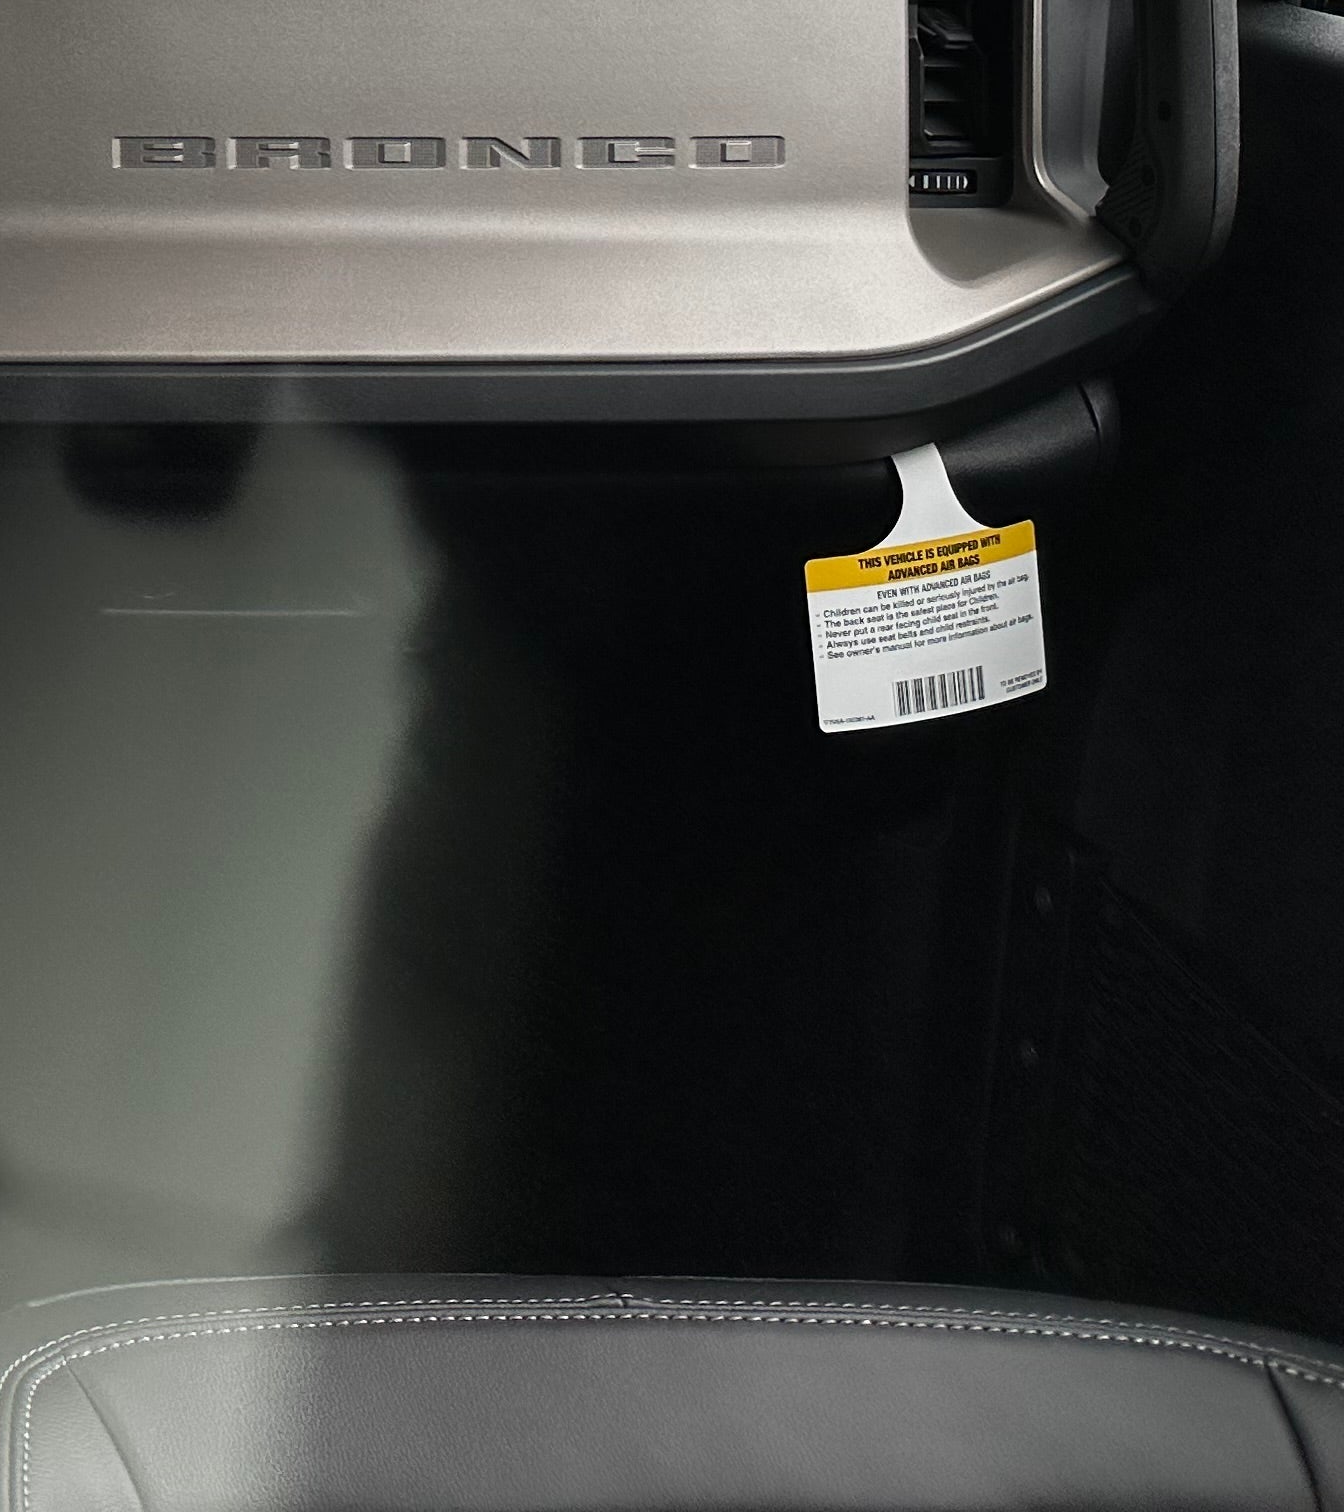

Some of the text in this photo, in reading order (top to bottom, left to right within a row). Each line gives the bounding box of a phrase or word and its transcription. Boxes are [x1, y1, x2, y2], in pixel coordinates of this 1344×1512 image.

[113, 135, 786, 170] BRONCO
[858, 534, 1001, 569] THIS VEHICLE IS EQUIPPED WITH
[888, 554, 980, 581] ADVANCED AIR BAGS
[877, 570, 991, 600] EVEN WITH ADVANCED BAGS
[823, 591, 960, 618] Children seriously
[824, 617, 864, 628] The back
[825, 619, 921, 638] Never facing
[827, 638, 859, 650] Always
[827, 646, 880, 659] See owner's
